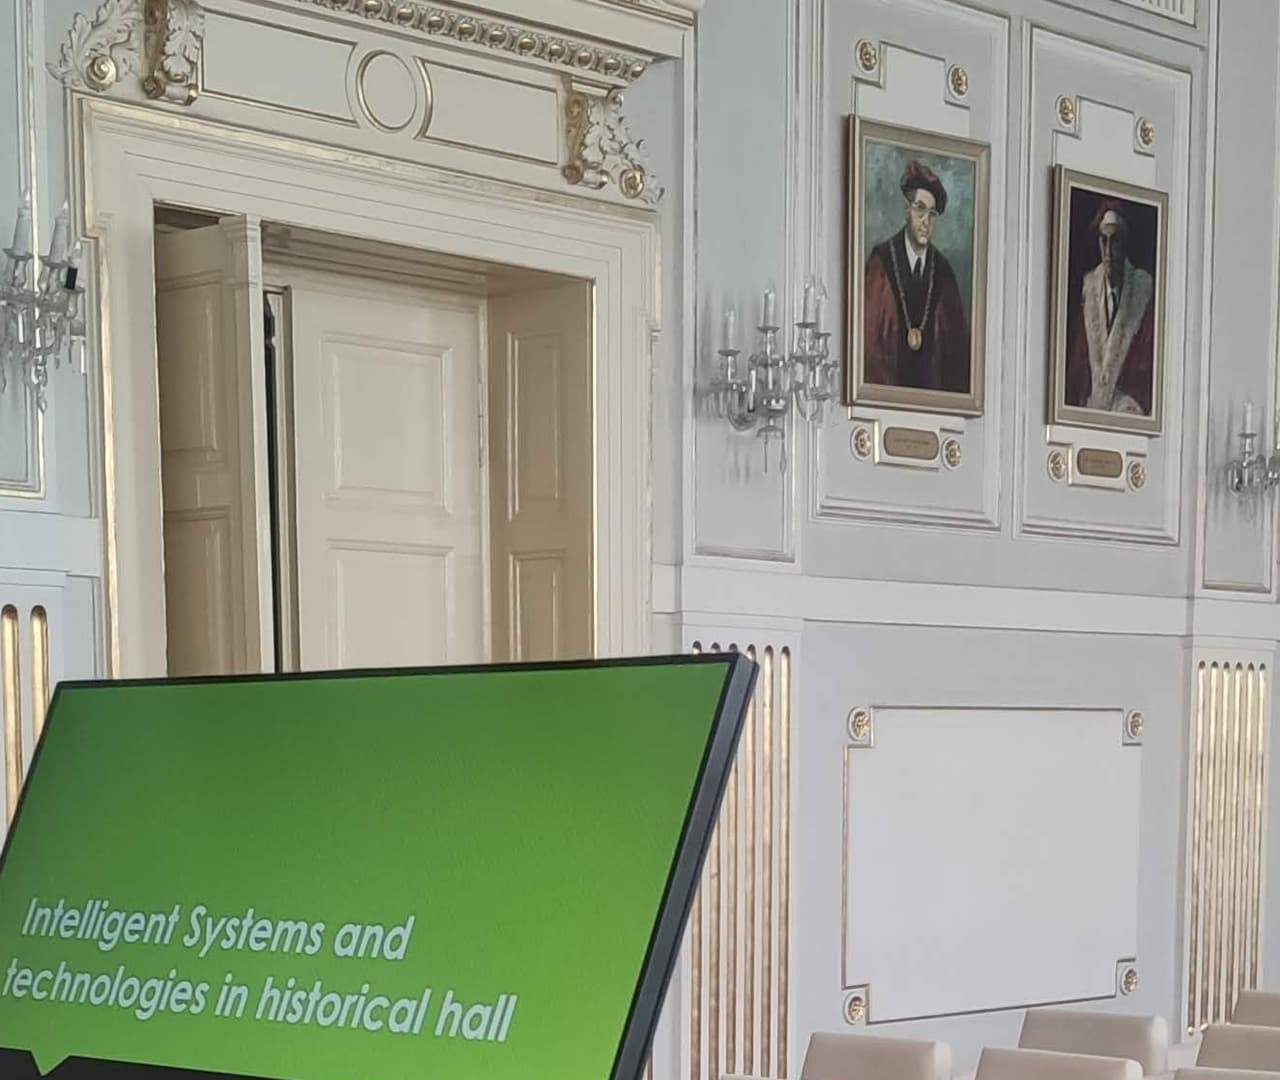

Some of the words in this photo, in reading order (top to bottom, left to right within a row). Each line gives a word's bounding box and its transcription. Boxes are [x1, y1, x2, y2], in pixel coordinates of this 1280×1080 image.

[21, 897, 180, 951] Intelligent
[182, 904, 326, 958] Systems
[333, 914, 416, 961] and
[2, 957, 210, 1020] technologies
[214, 972, 249, 1018] in
[255, 976, 432, 1035] historical
[434, 989, 518, 1042] hall
